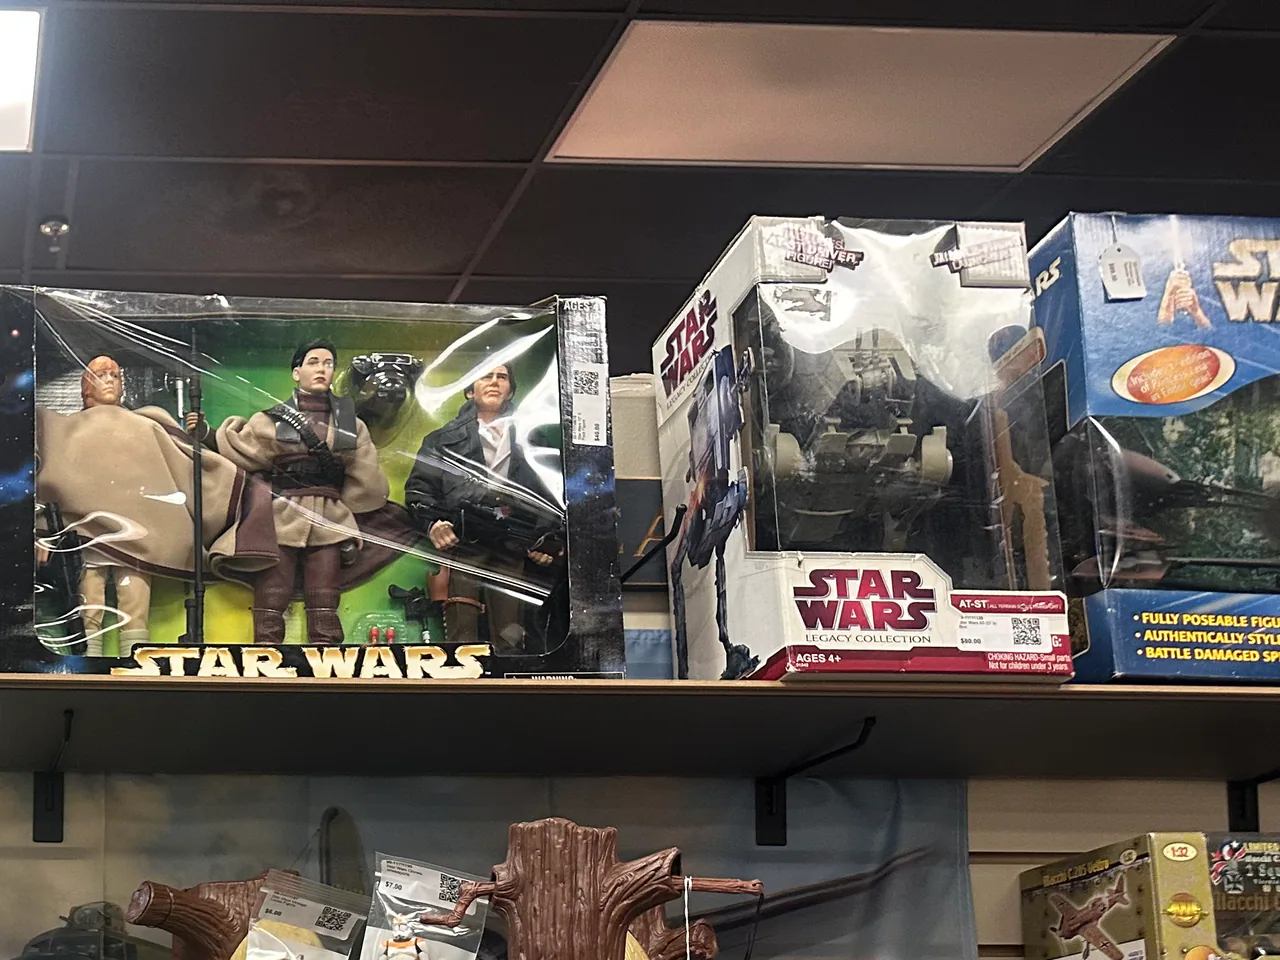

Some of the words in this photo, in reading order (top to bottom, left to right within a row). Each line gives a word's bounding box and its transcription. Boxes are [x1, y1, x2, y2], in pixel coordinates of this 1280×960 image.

[564, 301, 591, 311] AGES
[660, 289, 718, 375] STAR
[661, 309, 718, 400] WARS
[793, 568, 935, 599] STAR
[959, 599, 987, 609] AT-ST
[794, 600, 938, 631] WARS
[1141, 612, 1180, 626] FULLY
[1183, 614, 1249, 628] POSEABLE
[805, 633, 853, 643] LEGACY
[855, 633, 932, 645] COLLECTION
[1144, 630, 1246, 645] AUTHENTICALLY
[796, 653, 826, 664] AGES
[828, 654, 842, 663] 4+
[987, 653, 1014, 661] CHOKING
[1014, 654, 1056, 662] HAZARD-Small
[1146, 647, 1193, 660] BATTLE
[1195, 649, 1261, 662] DAMAGED
[110, 646, 297, 679] STAR
[301, 645, 492, 680] WARS
[989, 661, 999, 669] Not
[1000, 661, 1008, 669] for
[1008, 661, 1031, 670] children
[1031, 662, 1047, 670] under
[384, 881, 403, 891] $7.00
